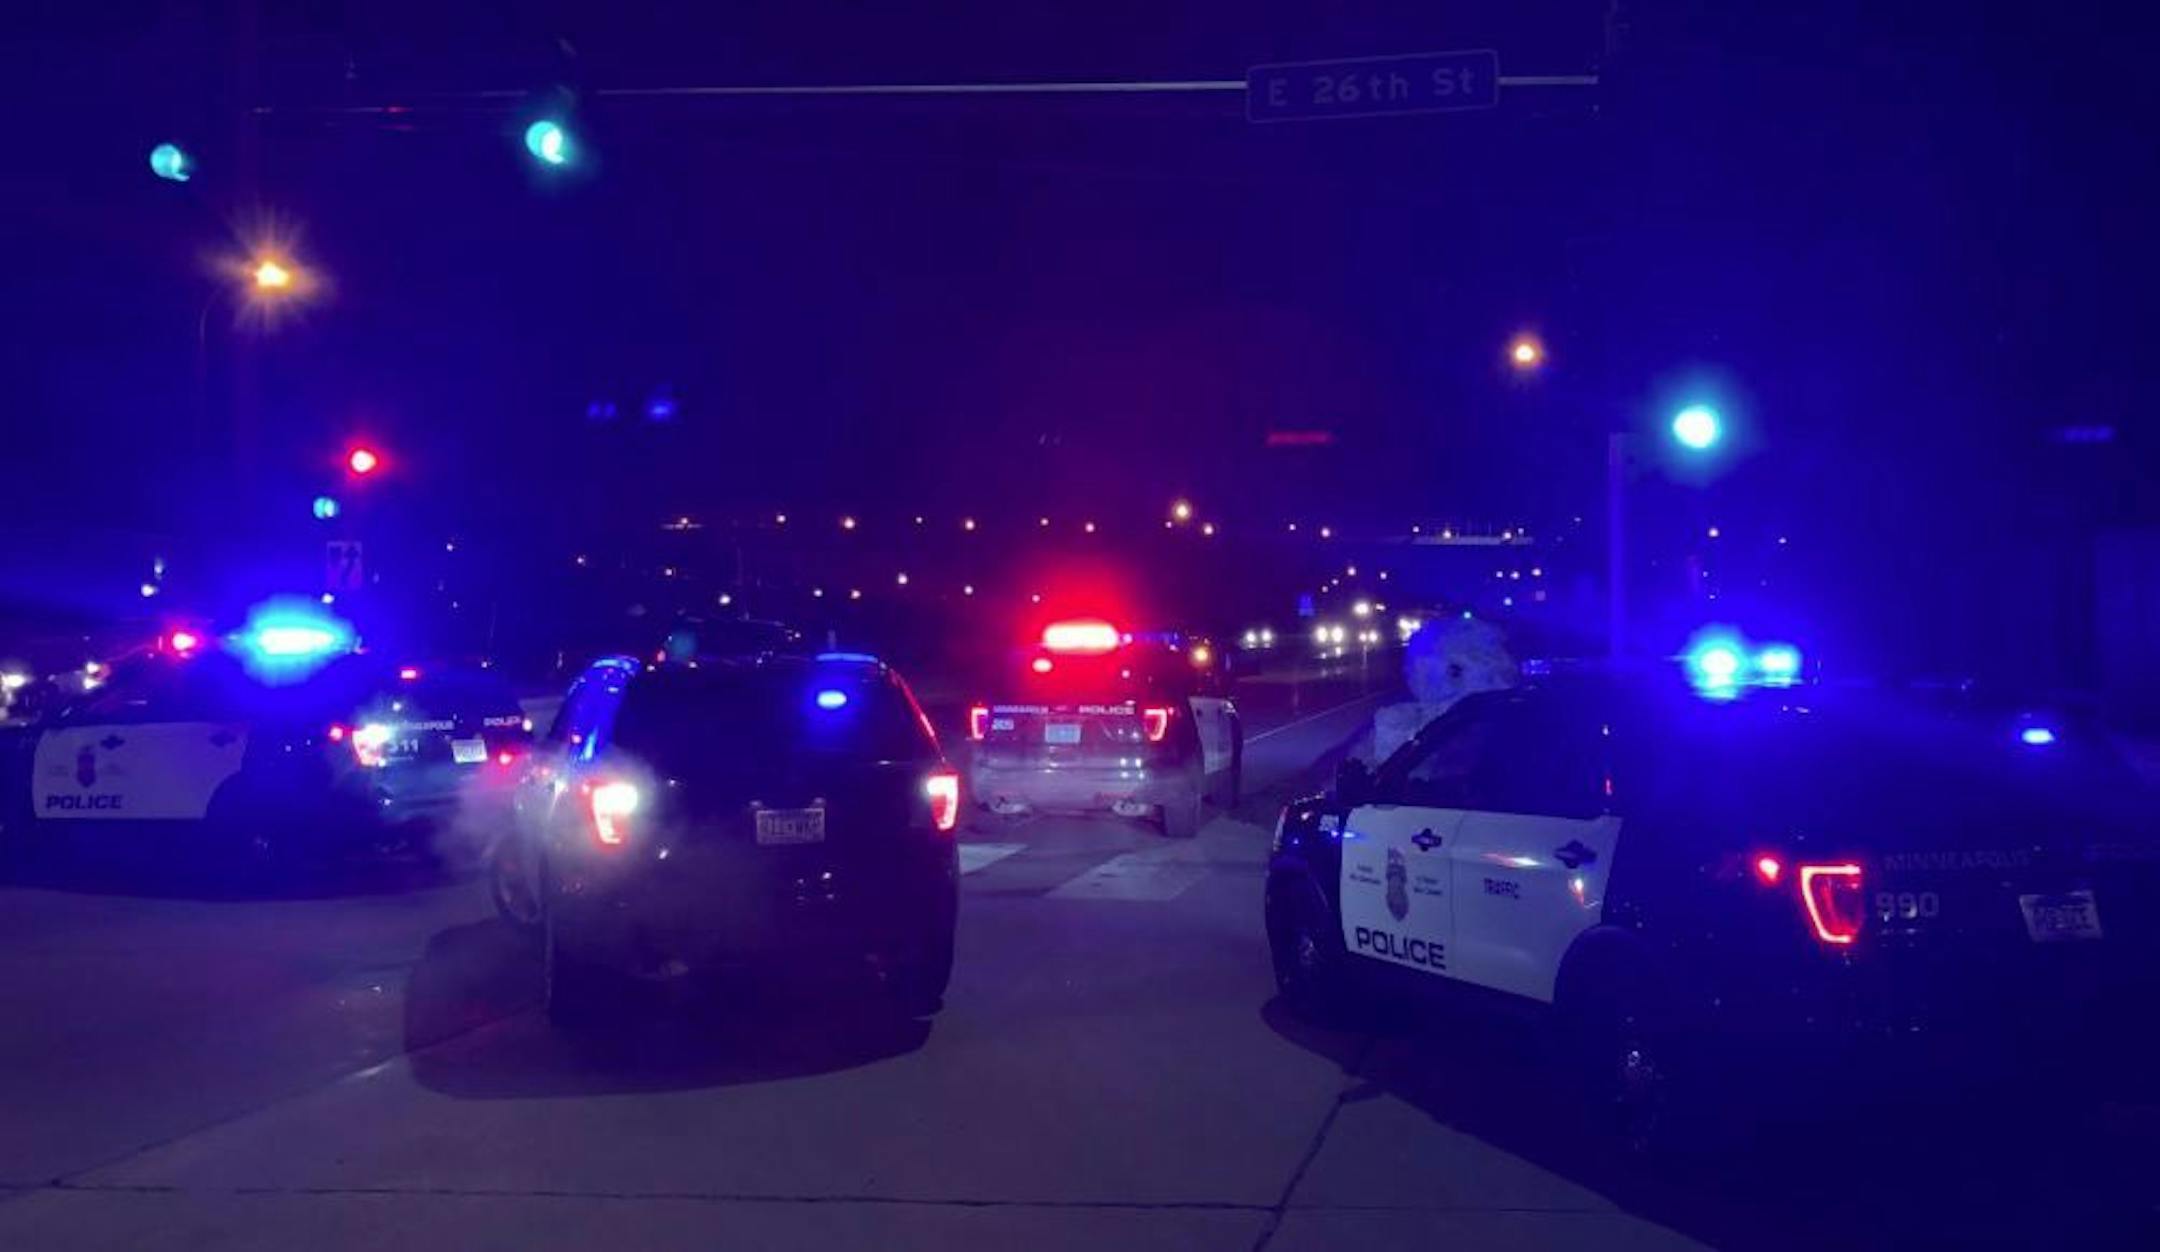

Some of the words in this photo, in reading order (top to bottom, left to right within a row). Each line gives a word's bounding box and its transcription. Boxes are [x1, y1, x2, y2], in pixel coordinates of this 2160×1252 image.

[1268, 77, 1289, 107] E
[1312, 71, 1410, 105] 26th
[1431, 67, 1475, 97] St
[46, 795, 122, 809] POLICE
[1884, 849, 2032, 871] MINNEAPOLIS
[1874, 891, 1940, 919] 990
[1356, 927, 1447, 970] POLICE
